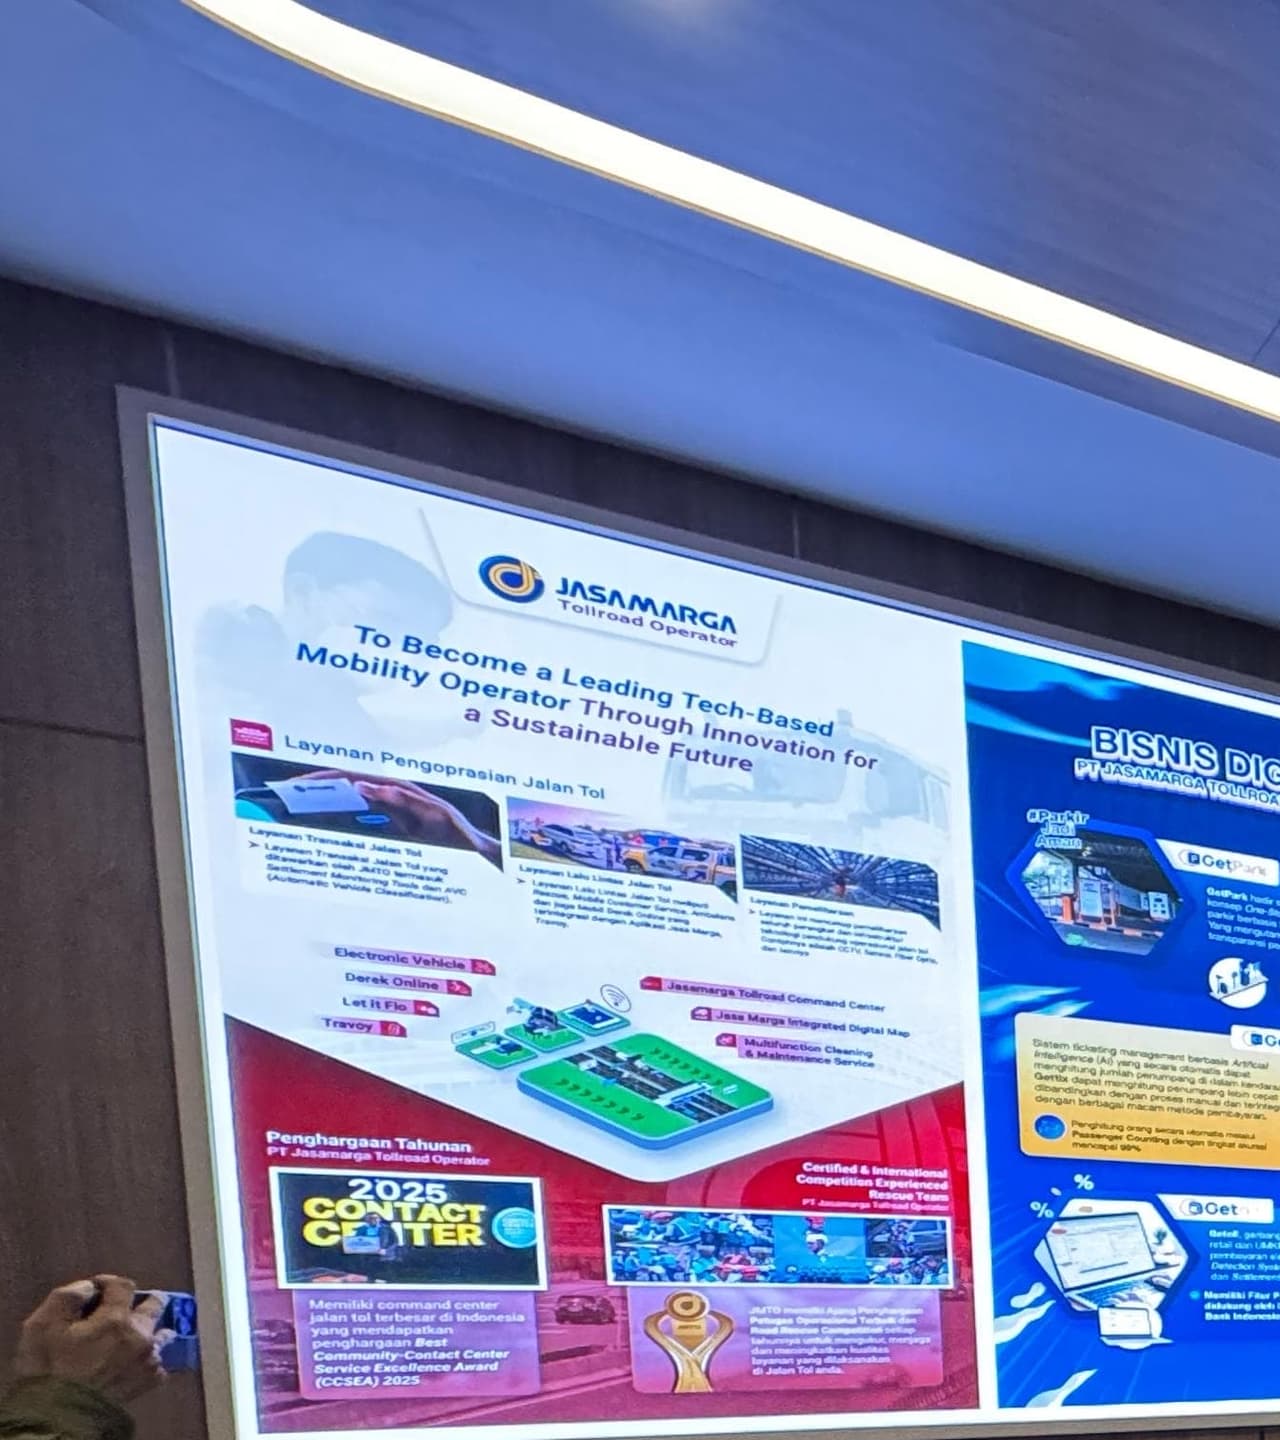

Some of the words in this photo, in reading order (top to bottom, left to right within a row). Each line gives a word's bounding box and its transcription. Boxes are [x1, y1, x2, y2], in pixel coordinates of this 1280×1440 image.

[554, 574, 737, 635] JASAMARGA
[558, 598, 644, 628] Tollroad
[649, 619, 737, 649] Operator
[353, 624, 391, 650] To
[401, 633, 527, 677] Become
[535, 665, 552, 682] a
[561, 666, 673, 710] Leading
[682, 691, 834, 737] Tech-Based
[294, 641, 430, 689] Mobility
[439, 669, 571, 712] Operator
[581, 697, 693, 736] Through
[702, 721, 835, 762] Innovation
[843, 748, 878, 770] for
[463, 706, 481, 723] a
[491, 707, 659, 755] Sustainable
[668, 741, 753, 772] Future
[1091, 725, 1219, 776] BISNIS
[284, 734, 374, 762] Layanan
[522, 775, 574, 795] Jalan
[577, 784, 605, 800] Tol
[1075, 757, 1099, 775] PT
[1103, 761, 1205, 793] JASAMARGA
[1026, 808, 1090, 826] #Parkir
[334, 947, 408, 964] Electronic
[413, 955, 466, 970] Vehicle
[345, 972, 388, 985] Derek
[392, 977, 439, 990] Online
[342, 997, 366, 1007] Let
[384, 1000, 407, 1011] Flo
[667, 980, 735, 998] Jasamarga
[738, 988, 784, 1002] Tollroad
[787, 993, 845, 1008] Command
[849, 1000, 885, 1012] Center
[323, 1018, 374, 1033] Travoy
[715, 1011, 744, 1021] Jasa
[747, 1014, 784, 1027] Marga
[787, 1018, 845, 1031] Integrated
[848, 1024, 884, 1035] Digital
[886, 1028, 910, 1040] Map
[744, 1037, 821, 1053] Multifunction
[824, 1045, 872, 1060] Cleaning
[745, 1049, 753, 1058] &
[757, 1050, 831, 1064] Maintenance
[834, 1057, 875, 1068] Service
[265, 1130, 391, 1149] Penghargaan
[394, 1138, 472, 1153] Tahunan
[266, 1146, 287, 1156] PT
[290, 1147, 371, 1162] Jasamarga
[374, 1151, 429, 1163] Tollroad
[431, 1154, 490, 1166] Operator
[802, 1161, 858, 1174] Certified
[859, 1164, 869, 1174] &
[871, 1165, 948, 1179] International
[346, 1177, 448, 1203] 2025
[795, 1173, 872, 1187] Competition
[875, 1177, 948, 1190] Experienced
[868, 1189, 913, 1200] Rescue
[914, 1191, 949, 1201] Team
[301, 1196, 487, 1224] CONTACT
[308, 1300, 373, 1309] Memiliki
[376, 1300, 451, 1309] command
[453, 1300, 499, 1309] center
[309, 1313, 348, 1324] jalan
[350, 1313, 372, 1322] tol
[374, 1313, 436, 1322] terbesar
[438, 1313, 453, 1322] di
[455, 1313, 525, 1322] Indonesia
[309, 1327, 349, 1337] yang
[351, 1325, 453, 1336] mendapatkan
[311, 1338, 412, 1349] penghargaan
[413, 1337, 449, 1346] Best
[463, 1349, 510, 1358] Center
[313, 1363, 369, 1373] Service
[372, 1362, 451, 1372] Excellence
[452, 1361, 499, 1371] Award
[382, 1375, 421, 1385] 2025
